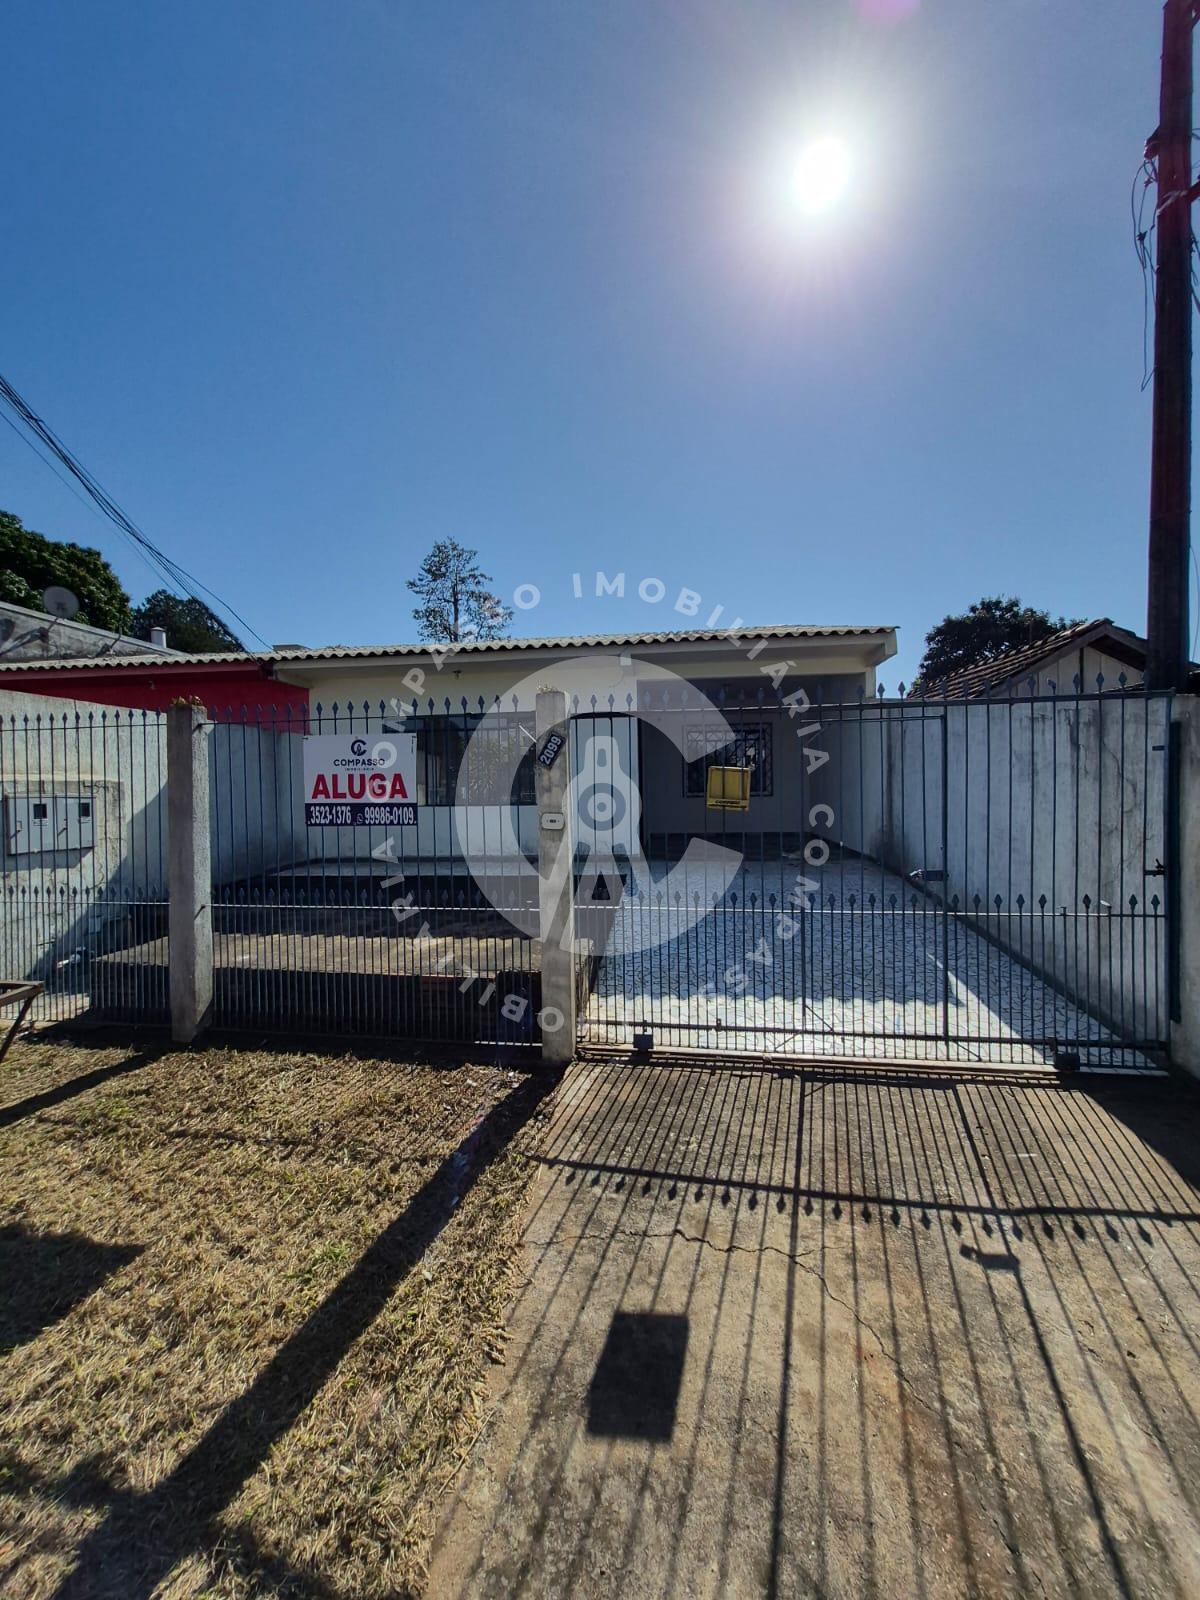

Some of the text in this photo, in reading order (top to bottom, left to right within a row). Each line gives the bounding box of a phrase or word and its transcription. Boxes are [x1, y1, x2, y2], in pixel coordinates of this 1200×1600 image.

[540, 736, 562, 765] 2099
[333, 758, 386, 767] COMPASSO
[311, 773, 408, 799] ALUGA
[310, 805, 351, 824] 3523-1376
